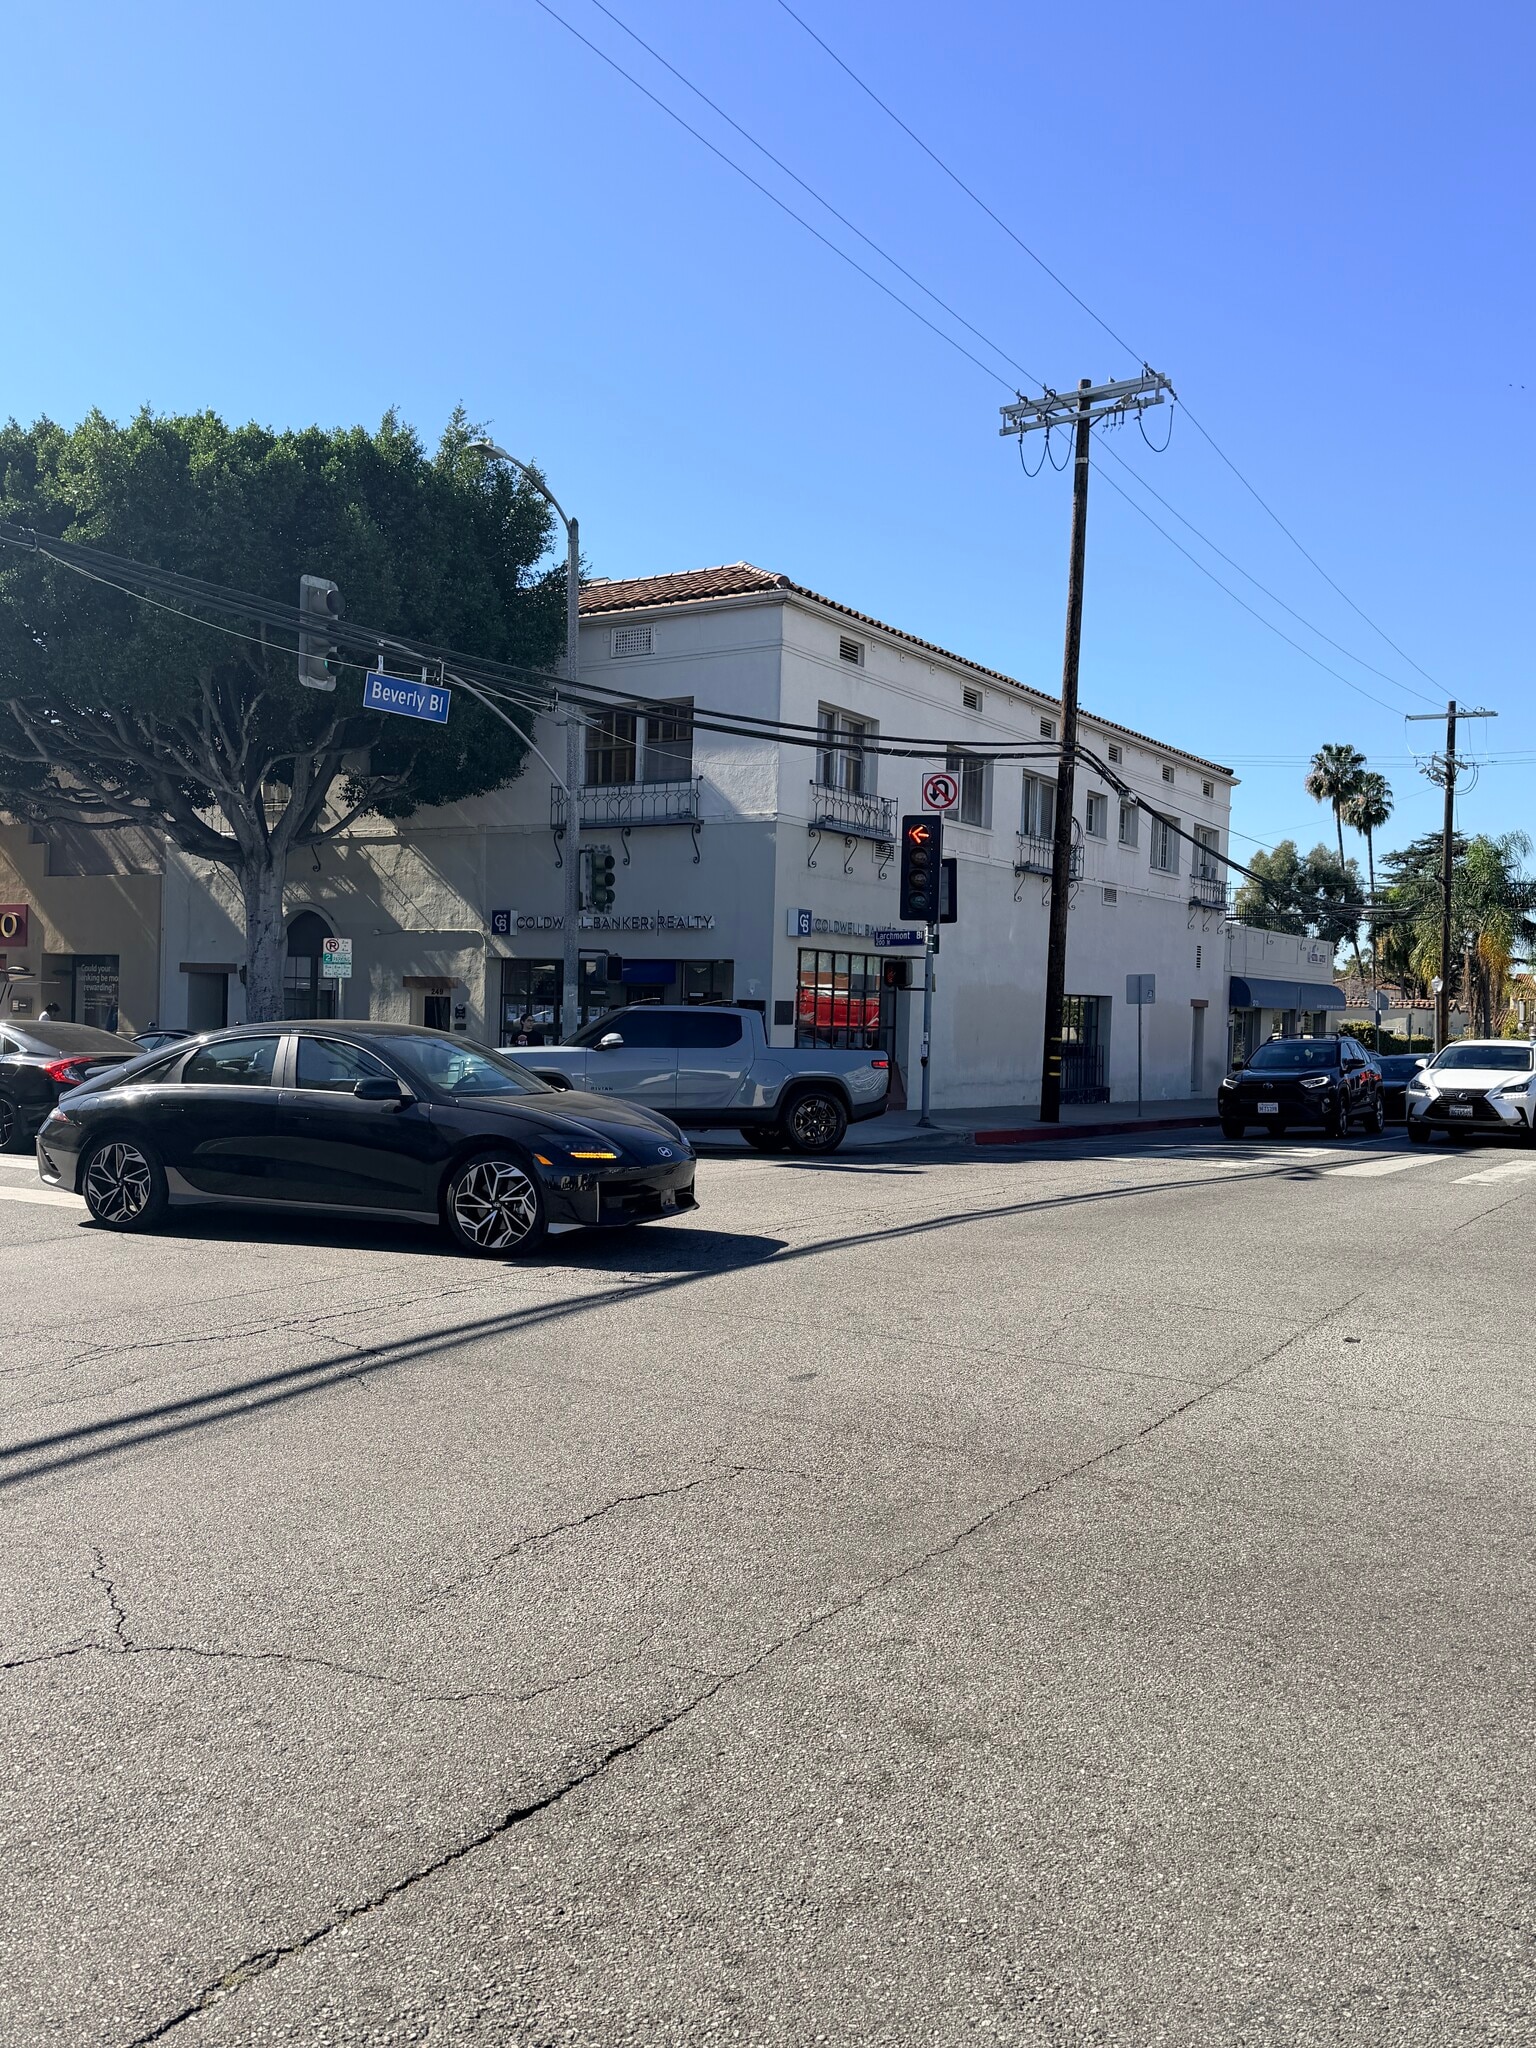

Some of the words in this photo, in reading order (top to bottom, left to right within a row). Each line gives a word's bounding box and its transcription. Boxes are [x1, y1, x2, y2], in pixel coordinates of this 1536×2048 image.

[372, 681, 425, 712] Beverly
[429, 694, 444, 712] Bl
[516, 916, 592, 929] COLDWL
[593, 916, 649, 929] BANKER
[657, 915, 713, 929] REALTY
[815, 918, 862, 936] COLDWELL
[875, 930, 911, 940] Larchmont
[97, 965, 111, 973] your
